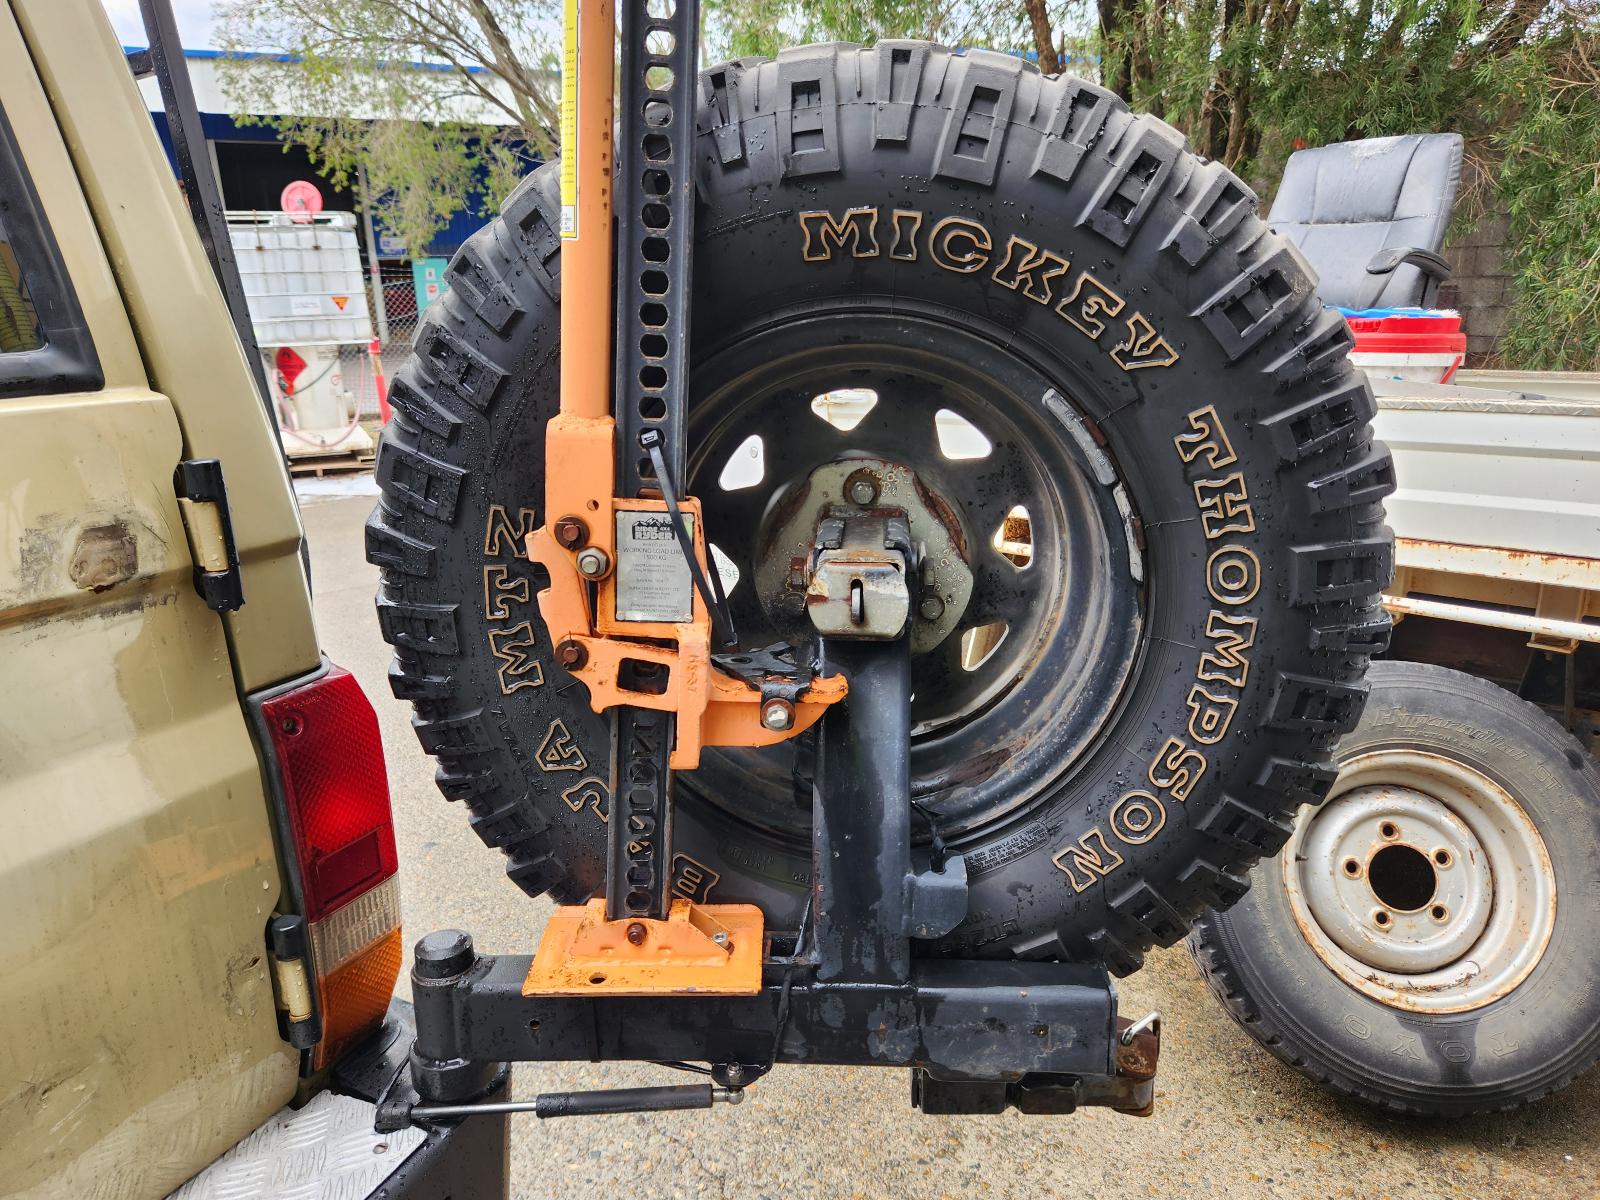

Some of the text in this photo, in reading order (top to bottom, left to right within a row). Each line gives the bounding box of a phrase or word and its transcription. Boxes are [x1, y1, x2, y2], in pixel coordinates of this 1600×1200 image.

[484, 503, 546, 696] MTZ
[635, 531, 672, 540] RYDER
[798, 207, 1180, 371] MICKEY
[1051, 404, 1261, 894] THOMPSON
[533, 717, 721, 904] BJA
[1344, 1013, 1522, 1064] TOYO
